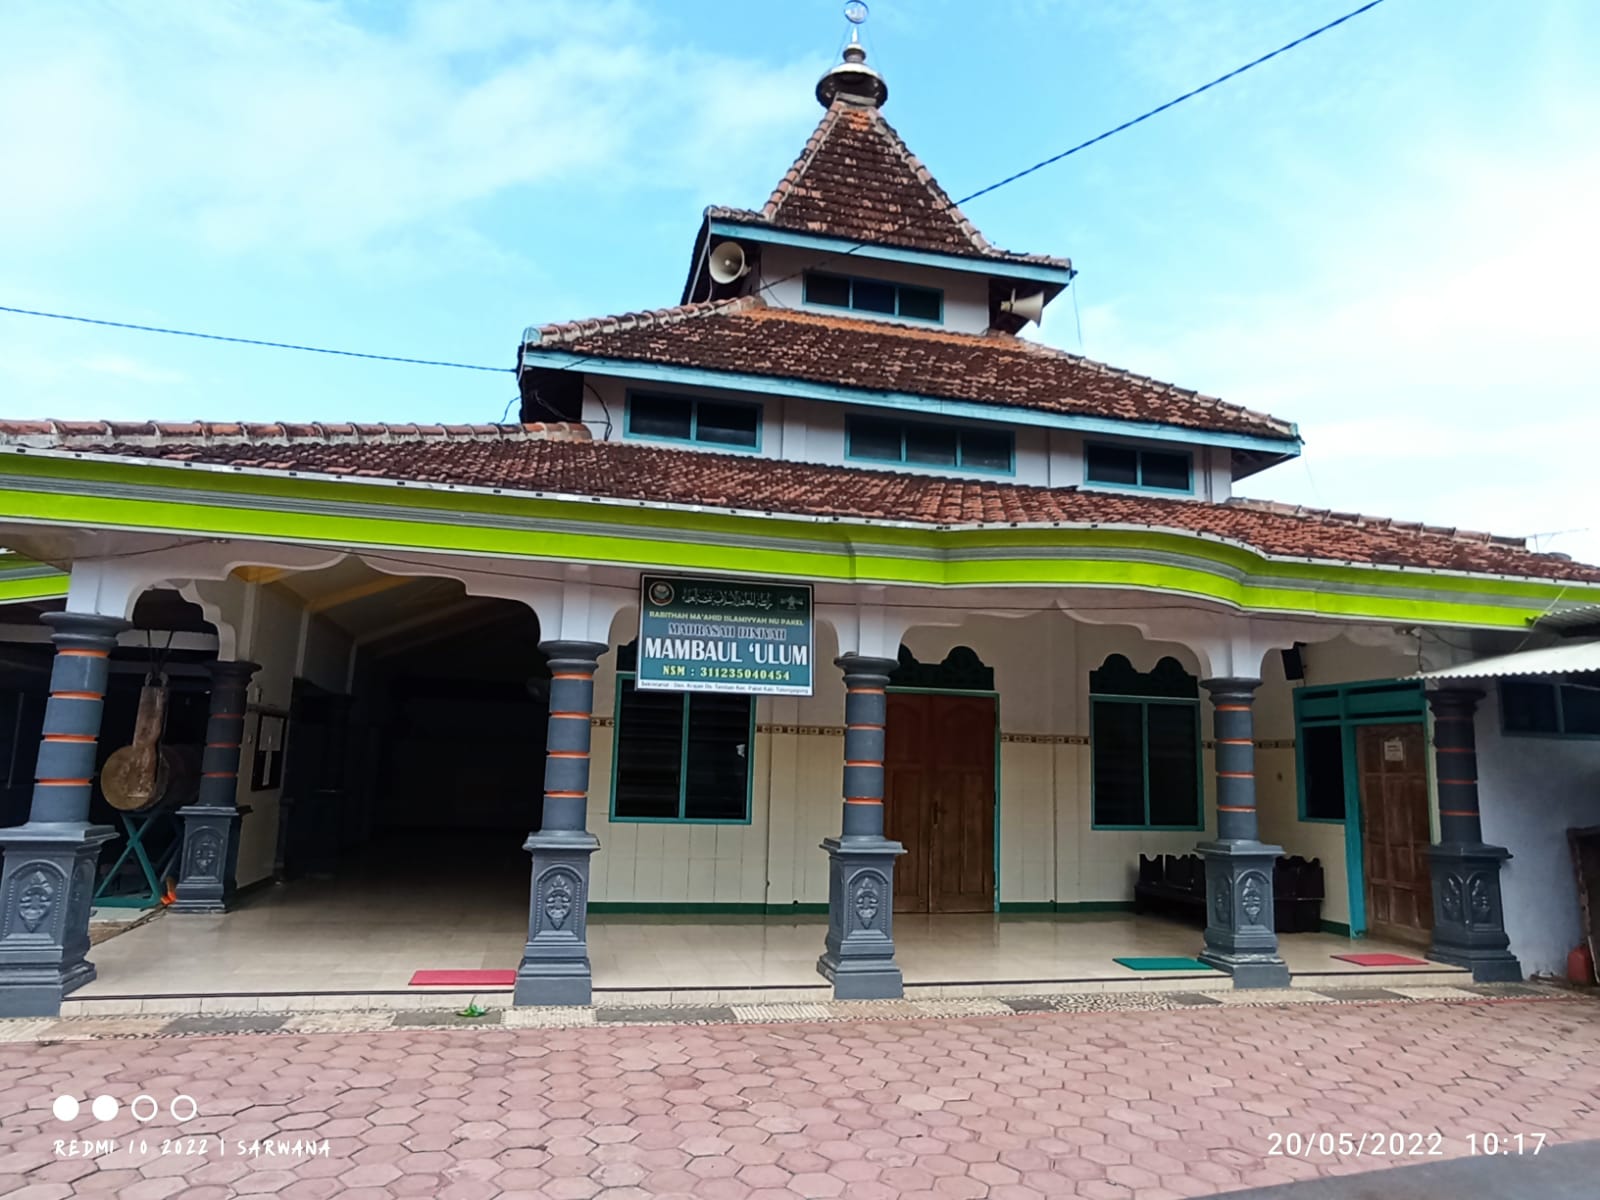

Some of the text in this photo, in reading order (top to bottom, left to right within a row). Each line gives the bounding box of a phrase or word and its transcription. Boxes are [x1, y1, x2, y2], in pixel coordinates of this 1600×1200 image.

[668, 622, 787, 640] MADRASAH DINIYAH
[645, 637, 743, 663] MAMBAUL
[662, 665, 685, 676] NSM
[700, 667, 790, 681] 311235040454
